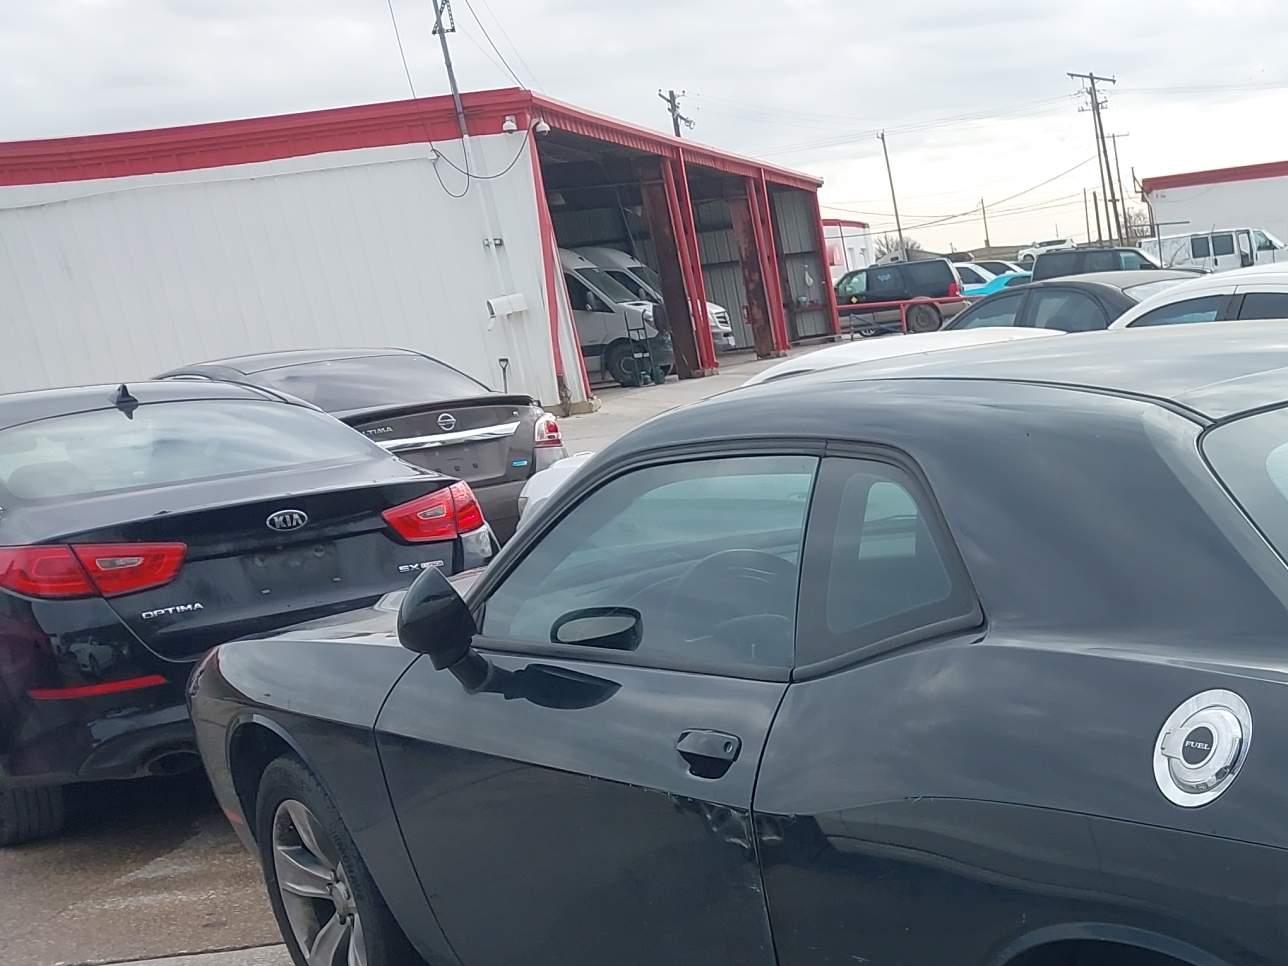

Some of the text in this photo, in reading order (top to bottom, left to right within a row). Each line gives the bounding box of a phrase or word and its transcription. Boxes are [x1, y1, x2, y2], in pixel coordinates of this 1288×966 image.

[272, 512, 304, 529] KIA
[141, 602, 204, 619] OPTIMA
[1184, 740, 1211, 750] FUEL
